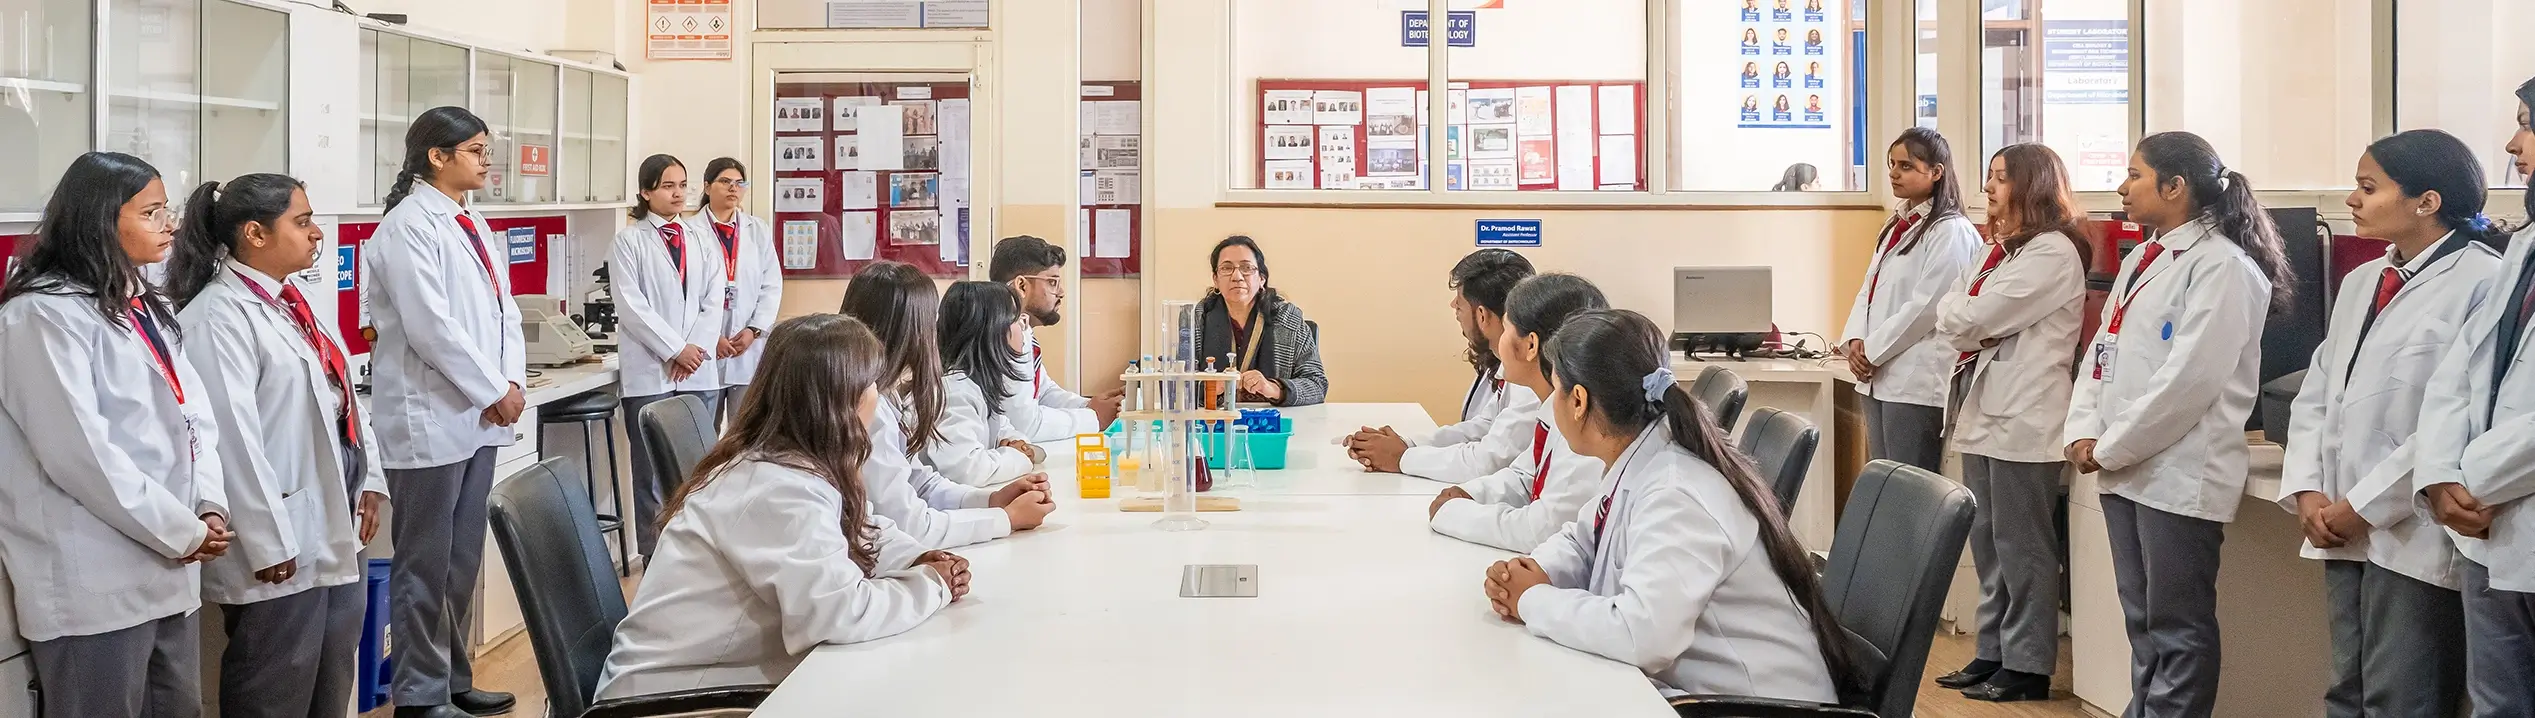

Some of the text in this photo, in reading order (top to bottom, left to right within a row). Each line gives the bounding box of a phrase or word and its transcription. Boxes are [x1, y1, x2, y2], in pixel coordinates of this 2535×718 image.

[1409, 20, 1468, 28] DEPANT OF
[1409, 30, 1468, 39] BIOTELOGY
